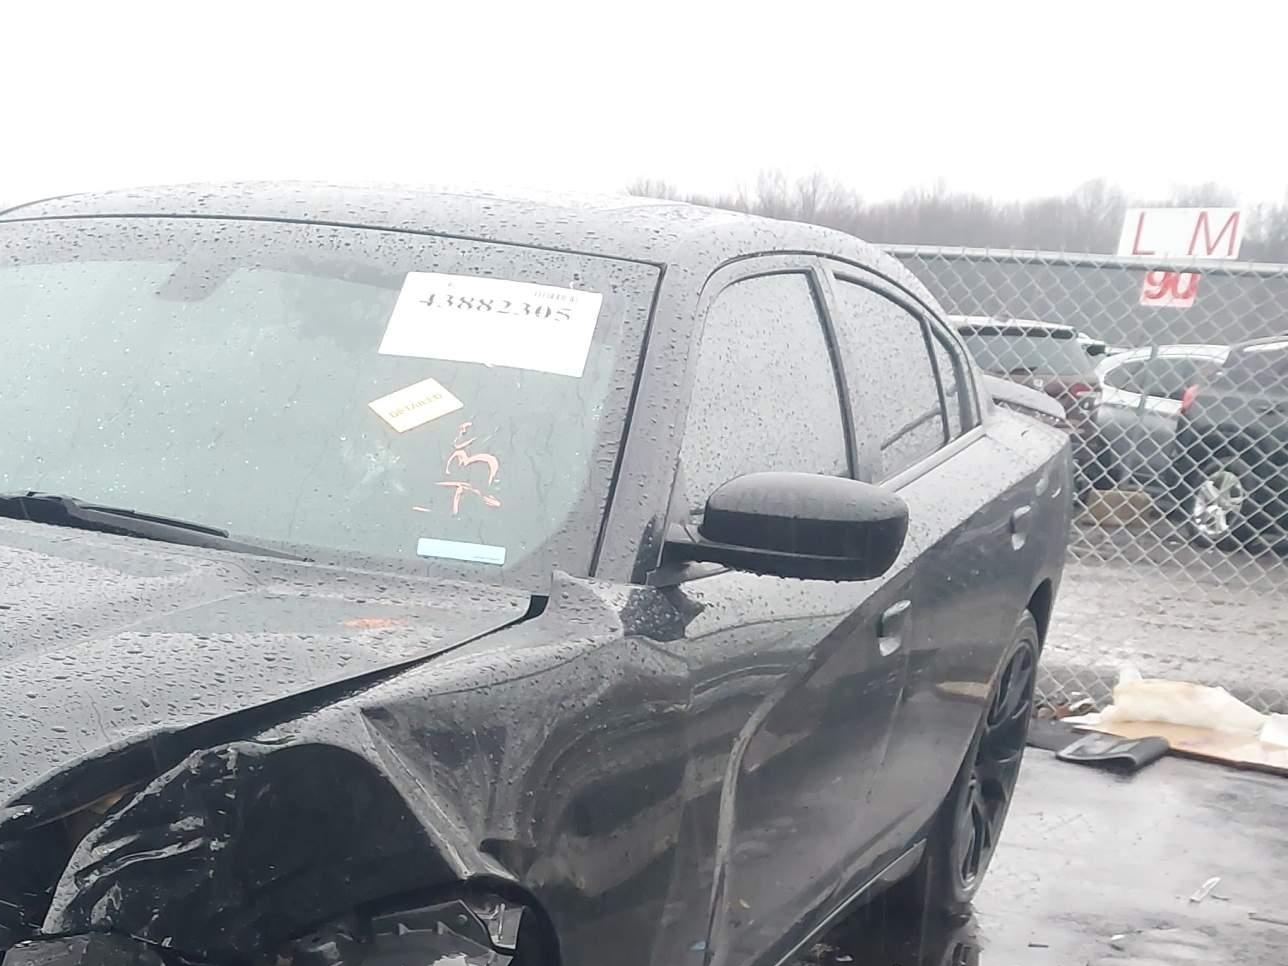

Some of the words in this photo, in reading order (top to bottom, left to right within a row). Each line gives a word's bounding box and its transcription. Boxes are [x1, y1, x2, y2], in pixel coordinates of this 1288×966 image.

[1131, 211, 1155, 256] L
[1187, 210, 1241, 257] M
[1143, 271, 1201, 300] 90
[418, 294, 573, 321] 43882305
